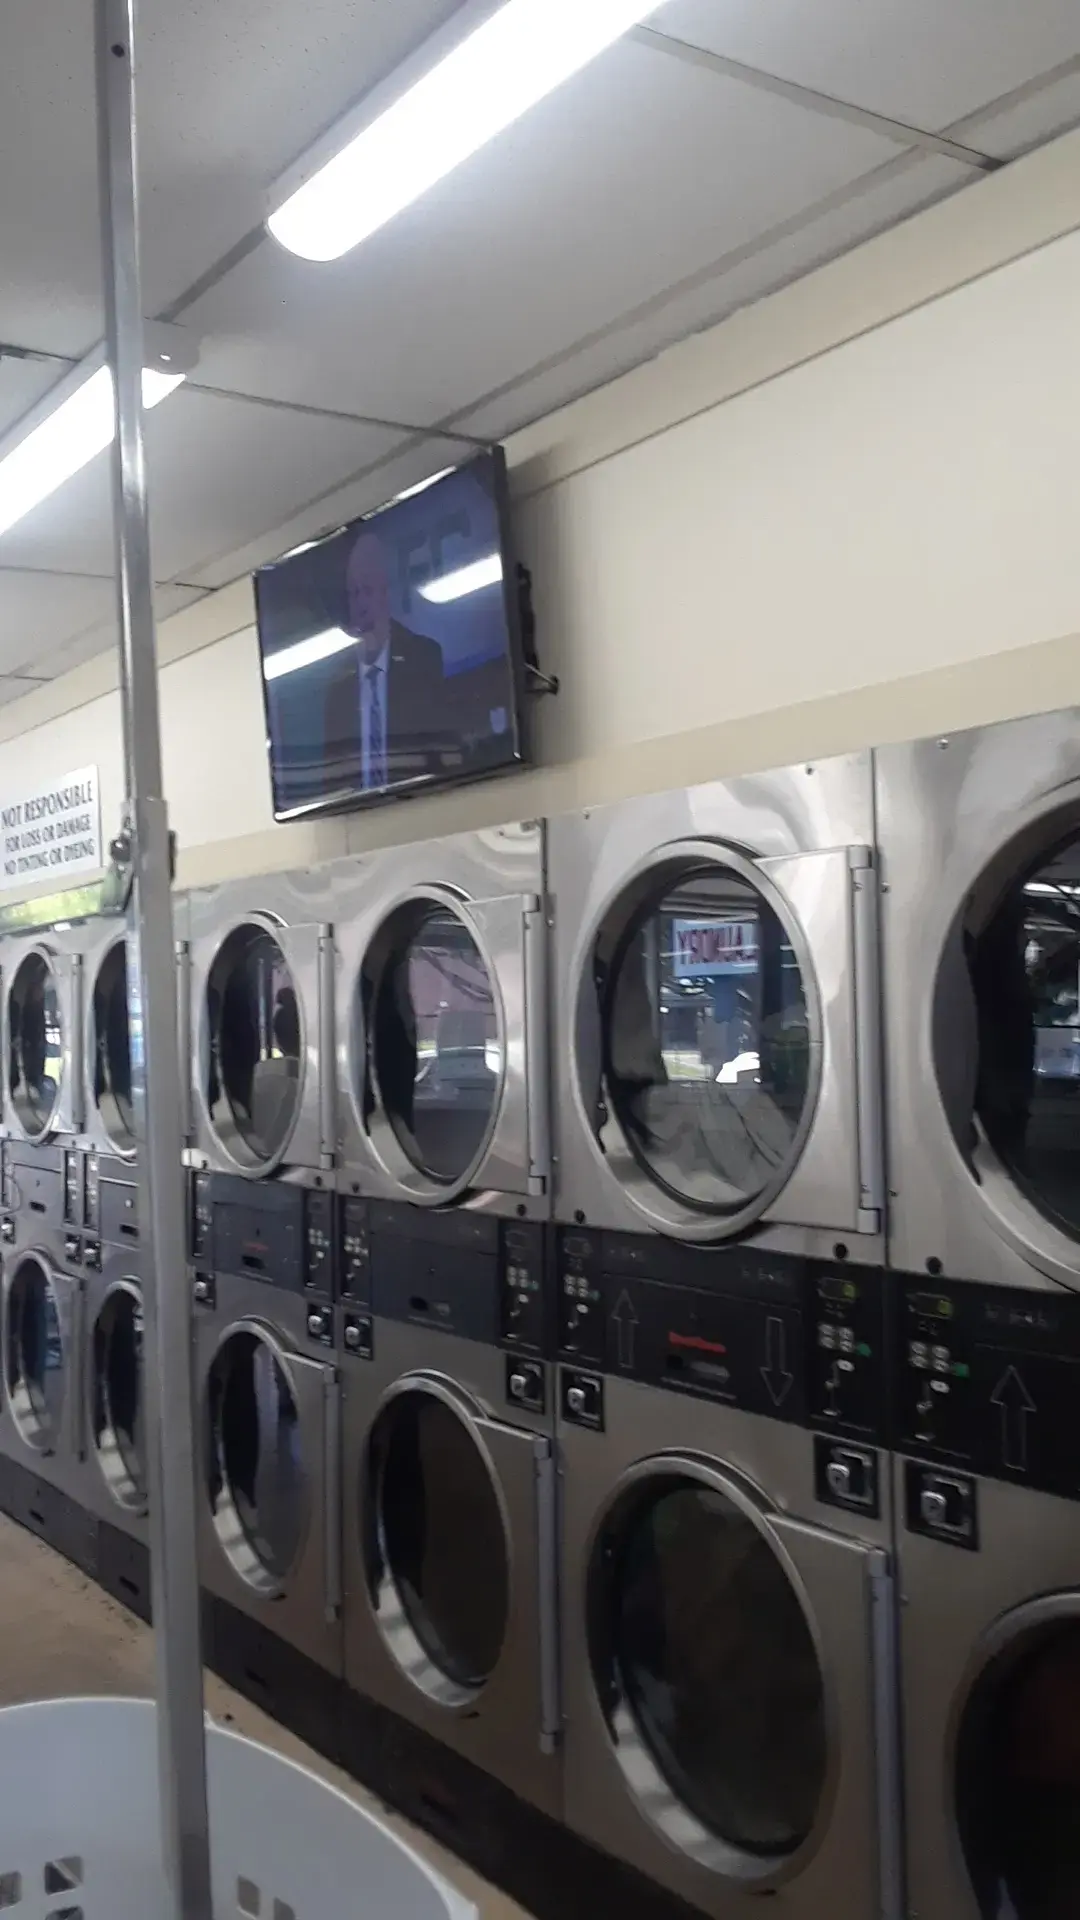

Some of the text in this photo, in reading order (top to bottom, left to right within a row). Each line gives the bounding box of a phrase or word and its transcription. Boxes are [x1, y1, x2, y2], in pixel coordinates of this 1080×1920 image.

[2, 780, 93, 829] NOT RESPONSIBLE
[5, 814, 91, 853] FOR LOSS OR DAMAGE
[4, 859, 17, 876] NO
[50, 847, 63, 865] OR
[64, 838, 95, 862] DYEING
